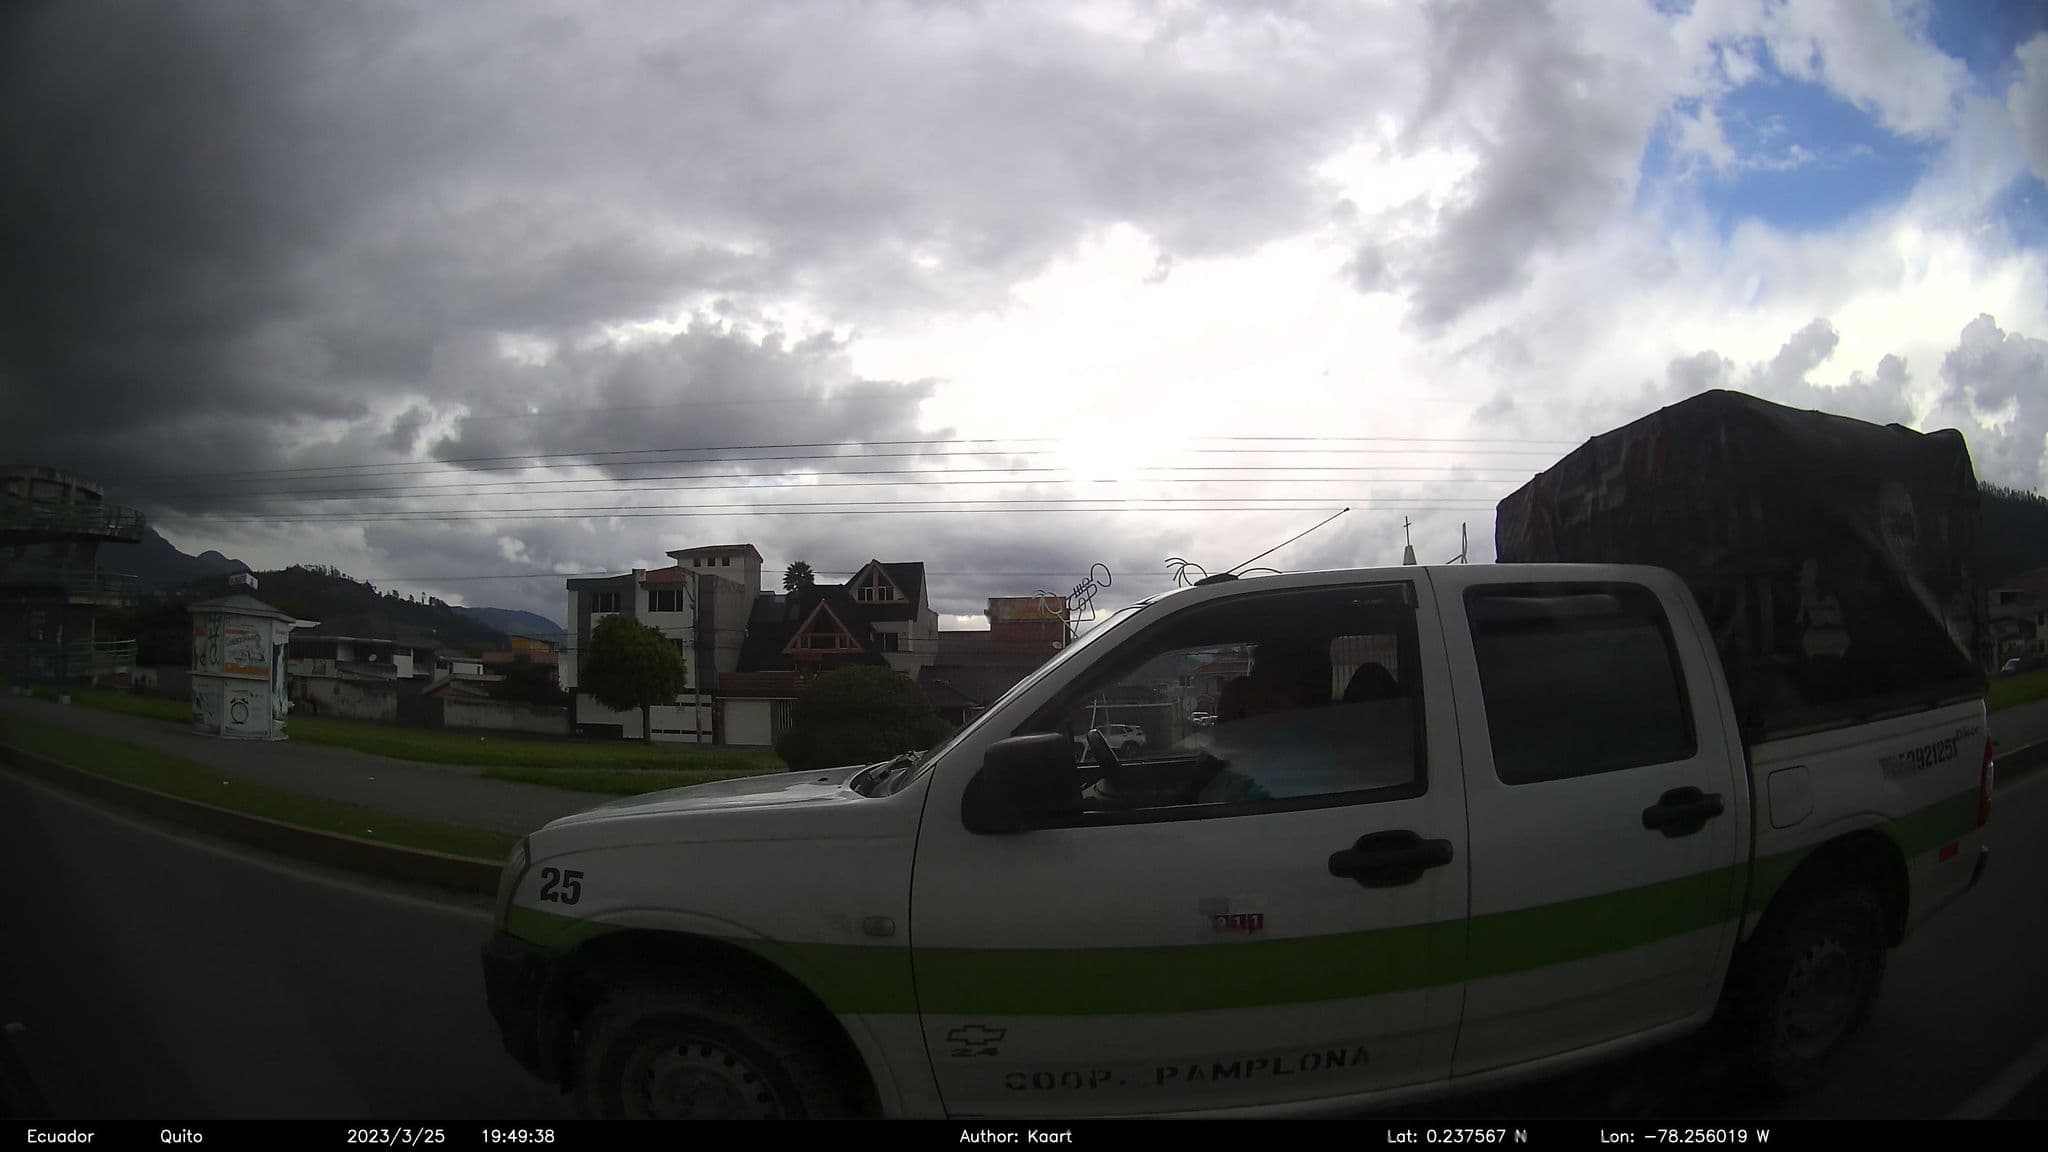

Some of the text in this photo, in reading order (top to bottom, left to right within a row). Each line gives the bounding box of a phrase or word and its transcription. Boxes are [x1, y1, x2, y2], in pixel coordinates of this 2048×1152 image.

[540, 867, 584, 906] 25
[1003, 1045, 1372, 1092] COOP. PAMPLONA
